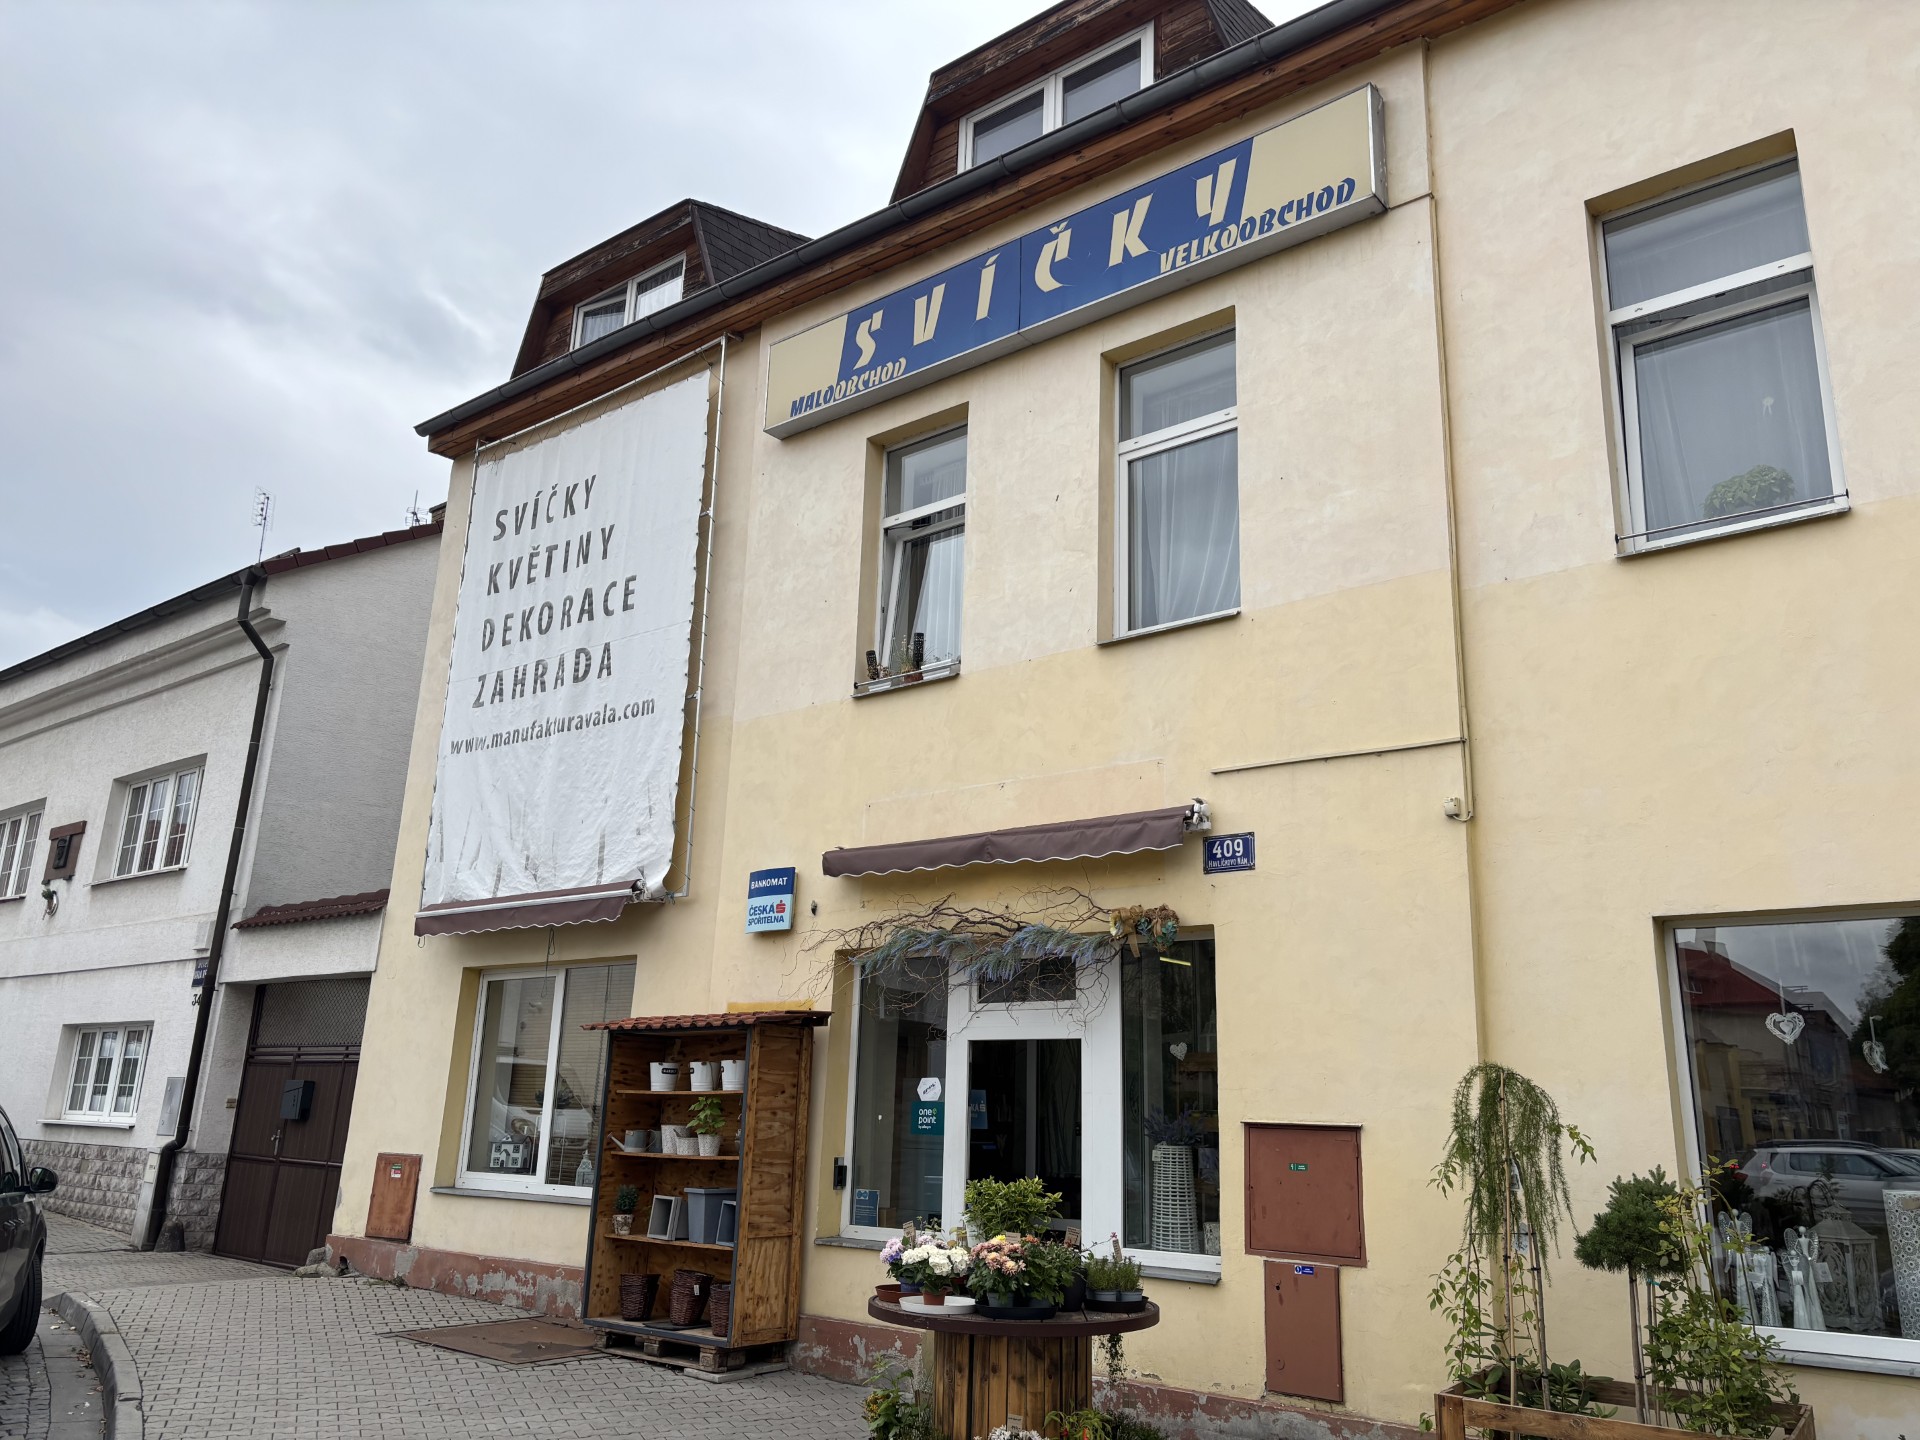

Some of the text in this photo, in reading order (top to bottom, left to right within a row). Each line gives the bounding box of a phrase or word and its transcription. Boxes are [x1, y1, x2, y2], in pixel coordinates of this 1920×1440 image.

[1159, 176, 1356, 275] VELKOOBCHOD
[853, 157, 1237, 370] SVÍČKY
[790, 356, 907, 418] MALOOBCHOD
[493, 474, 597, 542] SVÍČKY
[486, 524, 616, 596] KVĚTINY
[481, 575, 638, 652] DEKORACE
[472, 641, 612, 709] ZAHRADA
[450, 697, 656, 755] www.manufakturavala.com
[1213, 839, 1243, 858] 409
[749, 902, 775, 916] ČESKÁ
[751, 877, 787, 889] BANKOMAT
[748, 915, 784, 926] SPOŘITELNA
[918, 1108, 932, 1116] one
[918, 1116, 937, 1125] point
